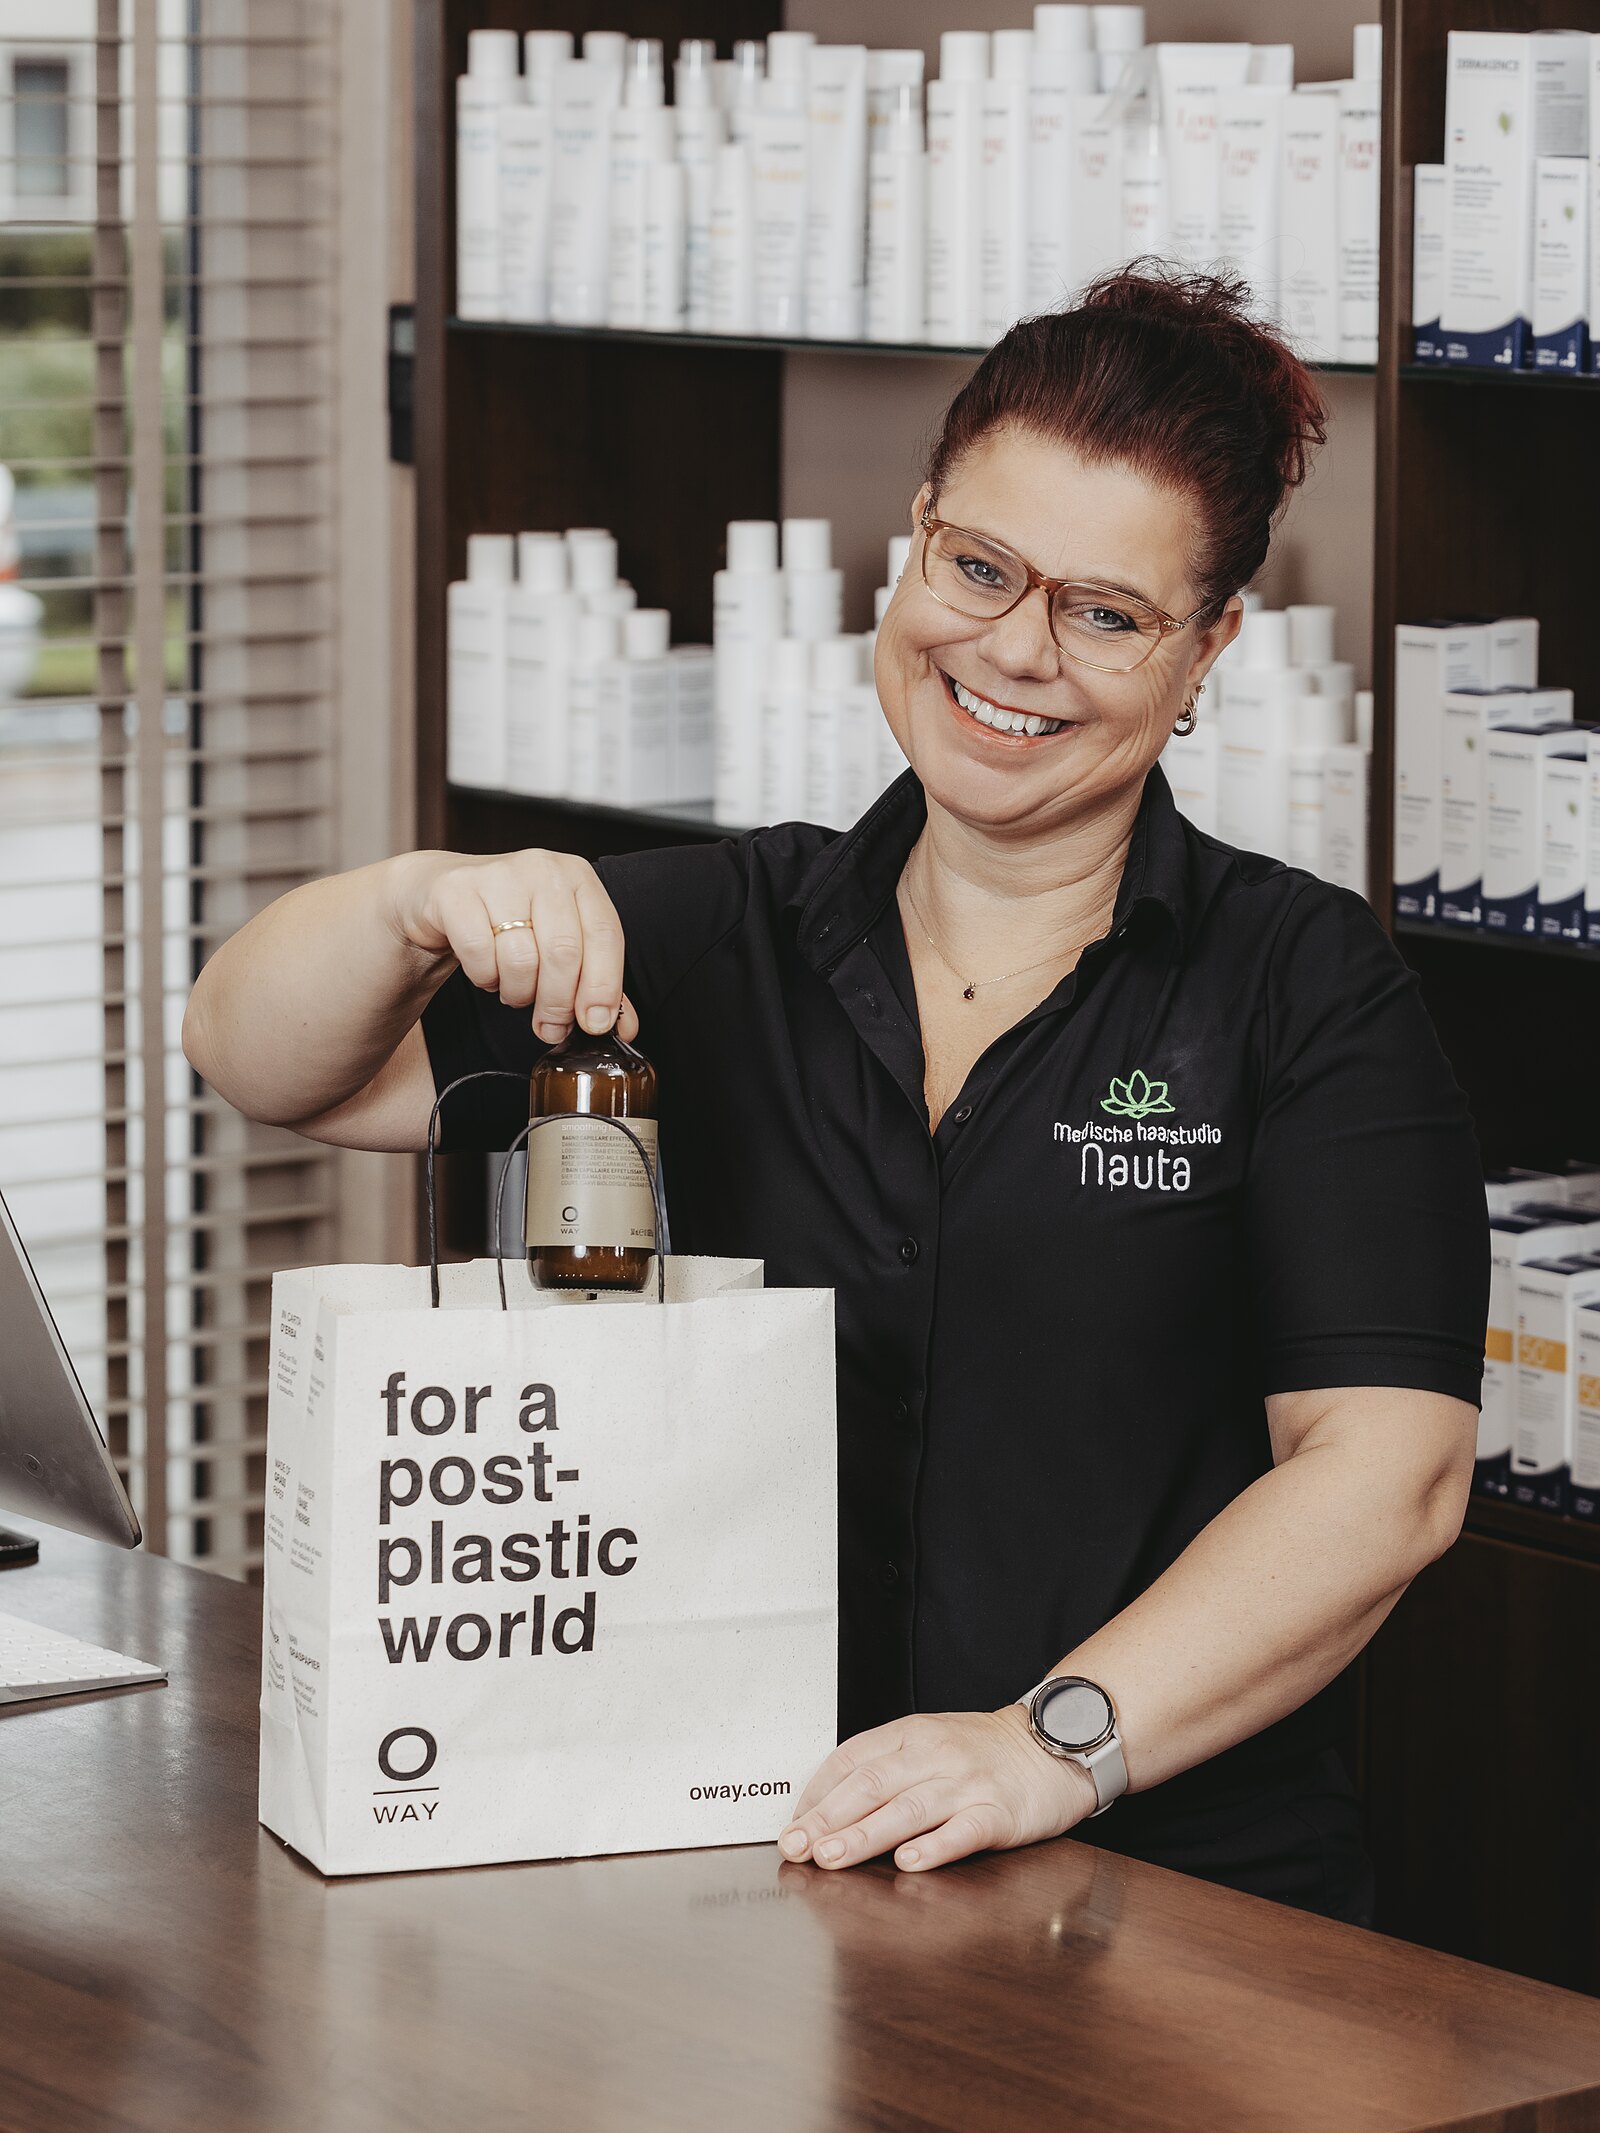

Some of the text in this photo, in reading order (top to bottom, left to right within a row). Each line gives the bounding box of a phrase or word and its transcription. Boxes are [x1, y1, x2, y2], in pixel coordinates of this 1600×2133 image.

[561, 1123, 607, 1133] smoothing
[1137, 1121, 1222, 1145] haarstudio
[1081, 1142, 1191, 1191] Nauta
[562, 1206, 578, 1222] O
[380, 1371, 492, 1436] for
[519, 1382, 560, 1433] a
[379, 1441, 580, 1525] post-
[378, 1513, 639, 1604] plastic
[377, 1591, 597, 1664] world
[378, 1726, 437, 1781] O
[373, 1801, 439, 1824] WAY
[689, 1780, 791, 1803] oway.com
